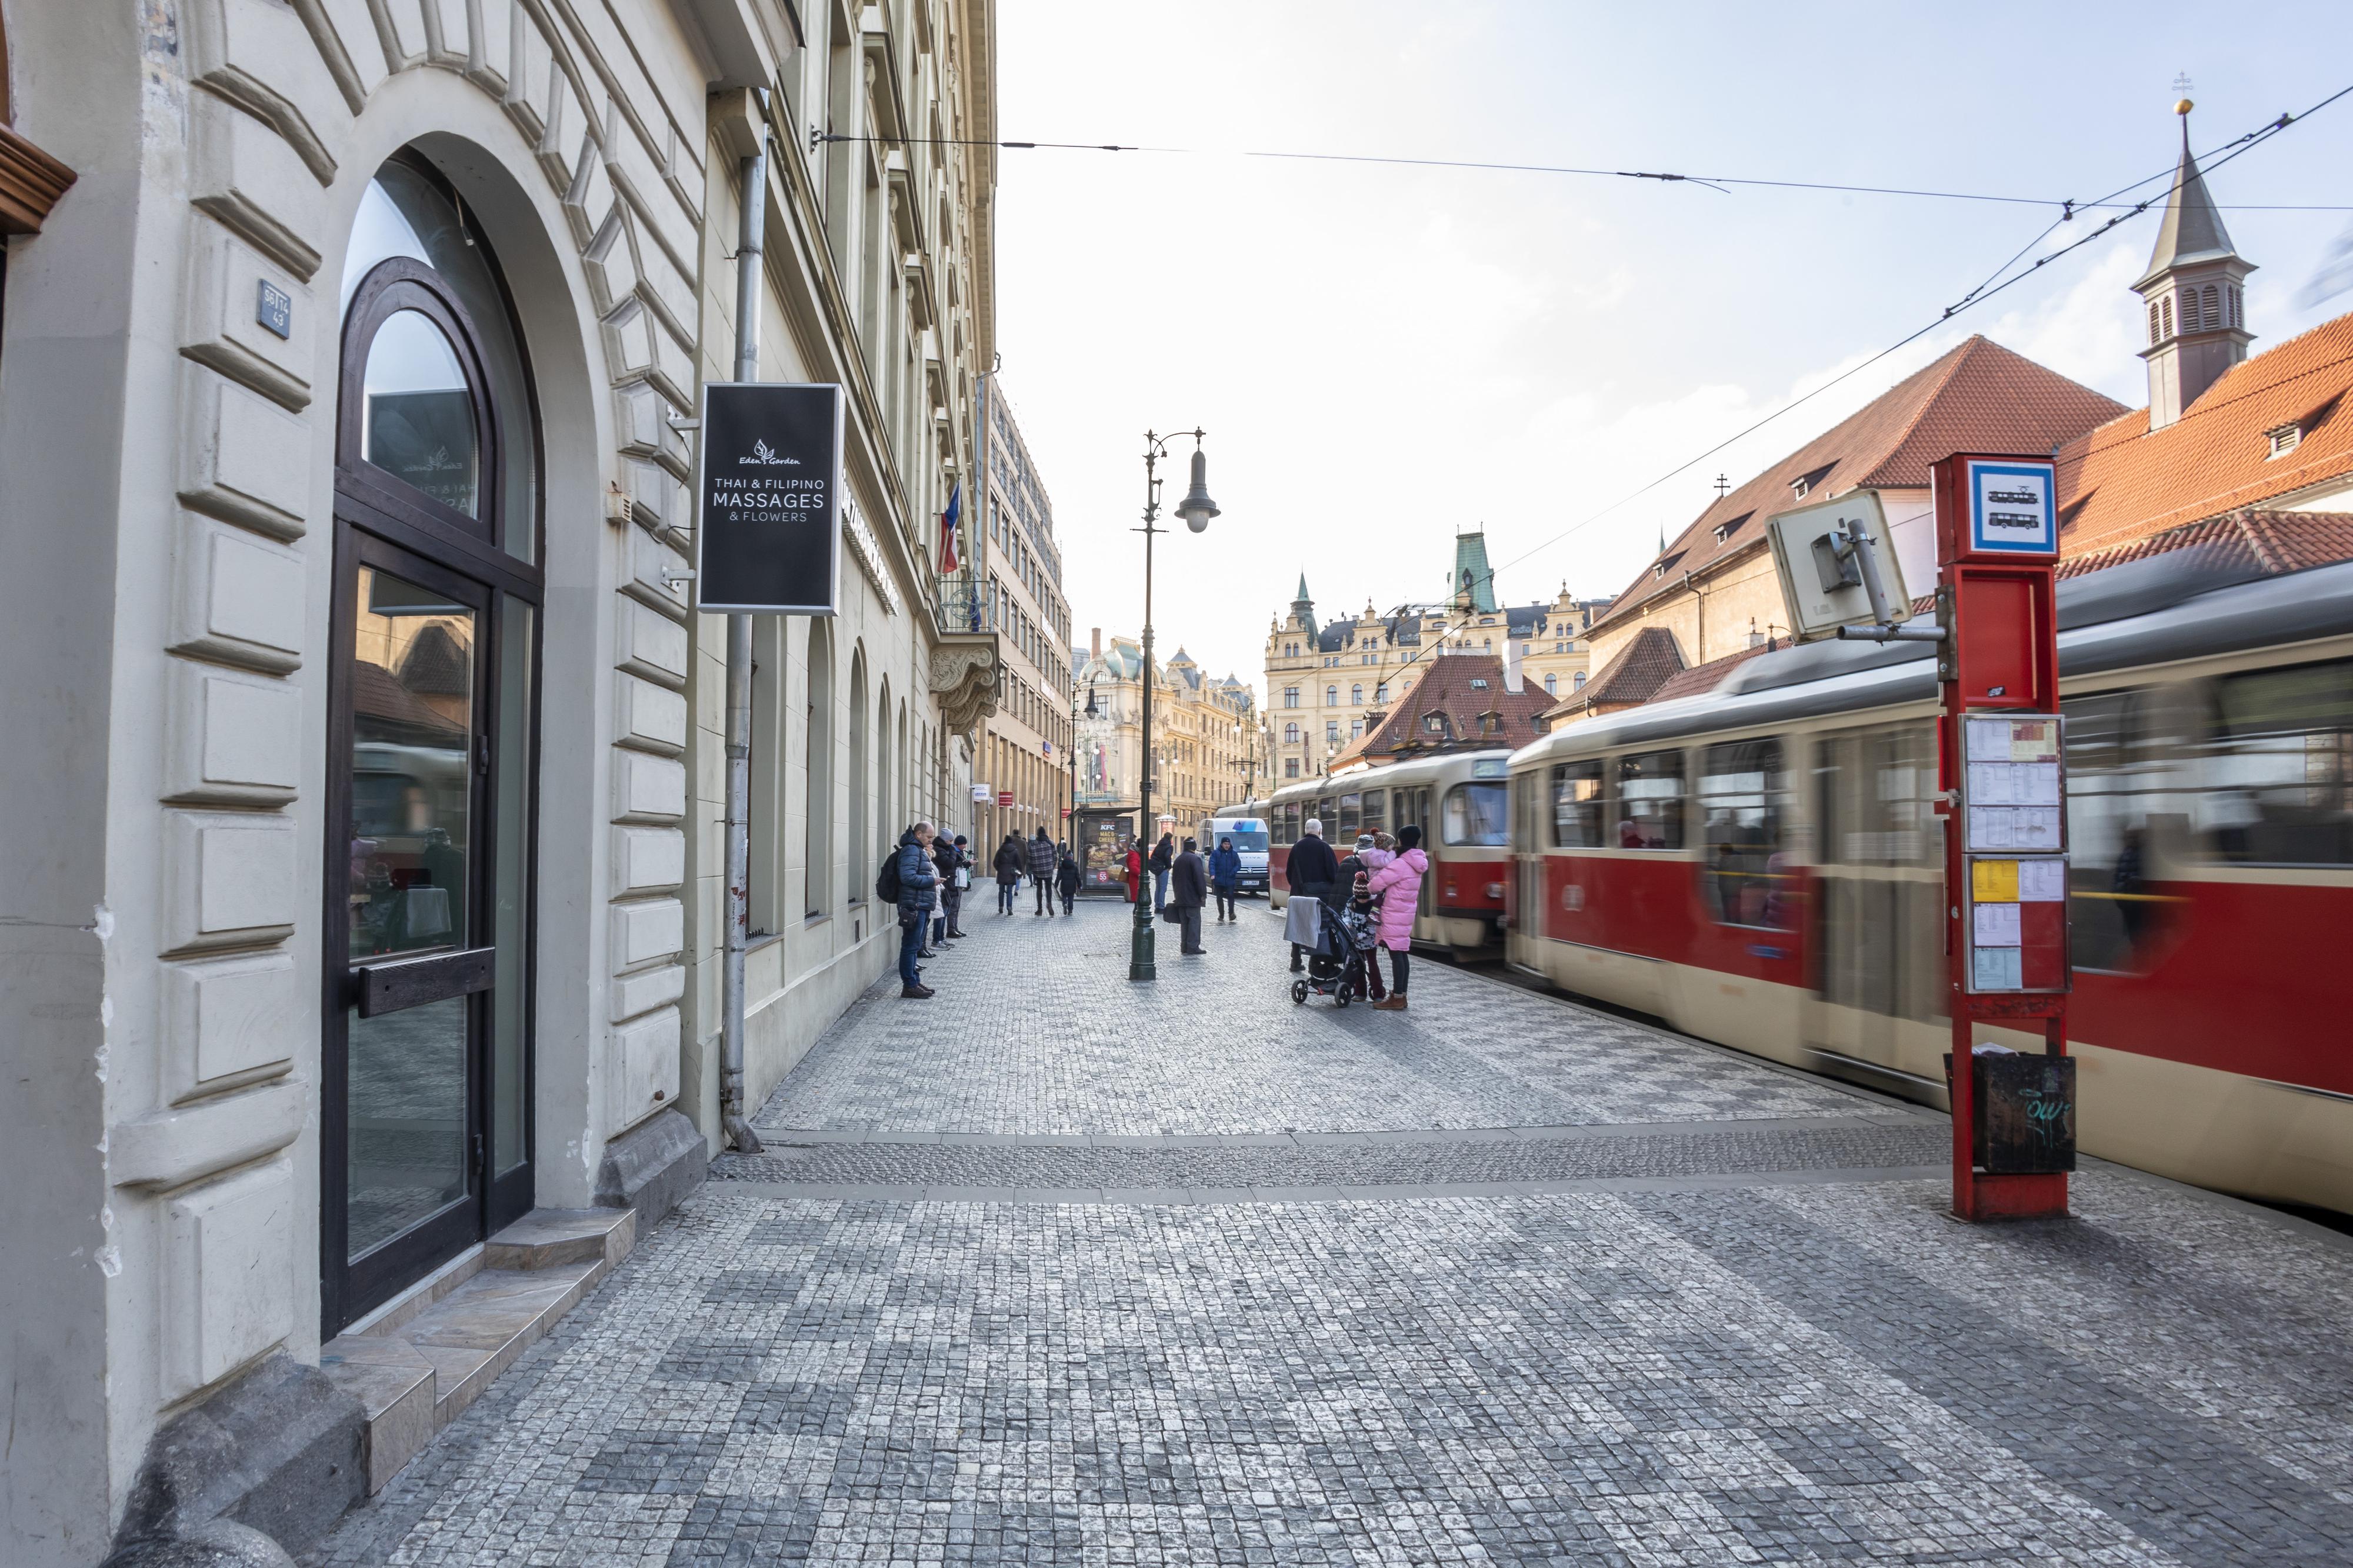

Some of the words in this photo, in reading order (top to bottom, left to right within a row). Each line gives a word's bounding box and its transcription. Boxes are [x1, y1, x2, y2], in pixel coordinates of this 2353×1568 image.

[739, 456, 766, 465] Eden's
[715, 478, 746, 488] THAI
[751, 479, 761, 488] &
[765, 479, 824, 489] FILIPINO
[714, 492, 824, 508] MASSAGES
[729, 511, 739, 521] &
[743, 512, 807, 522] FLOWERS
